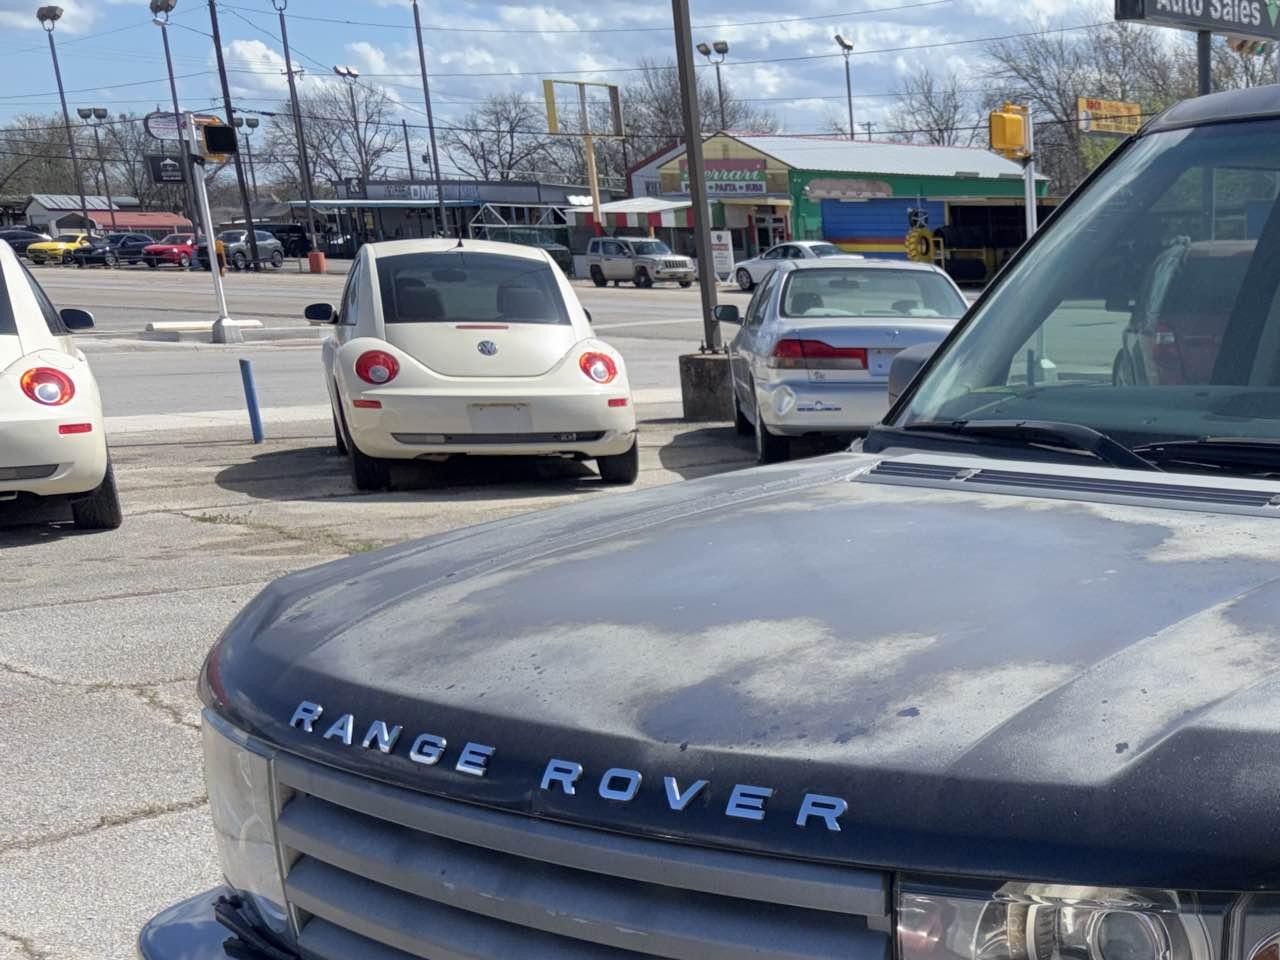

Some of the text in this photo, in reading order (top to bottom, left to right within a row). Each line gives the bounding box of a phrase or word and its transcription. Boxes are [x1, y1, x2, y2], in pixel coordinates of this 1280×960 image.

[1208, 0, 1261, 26] Sales
[289, 700, 848, 832] RANGE ROVER
